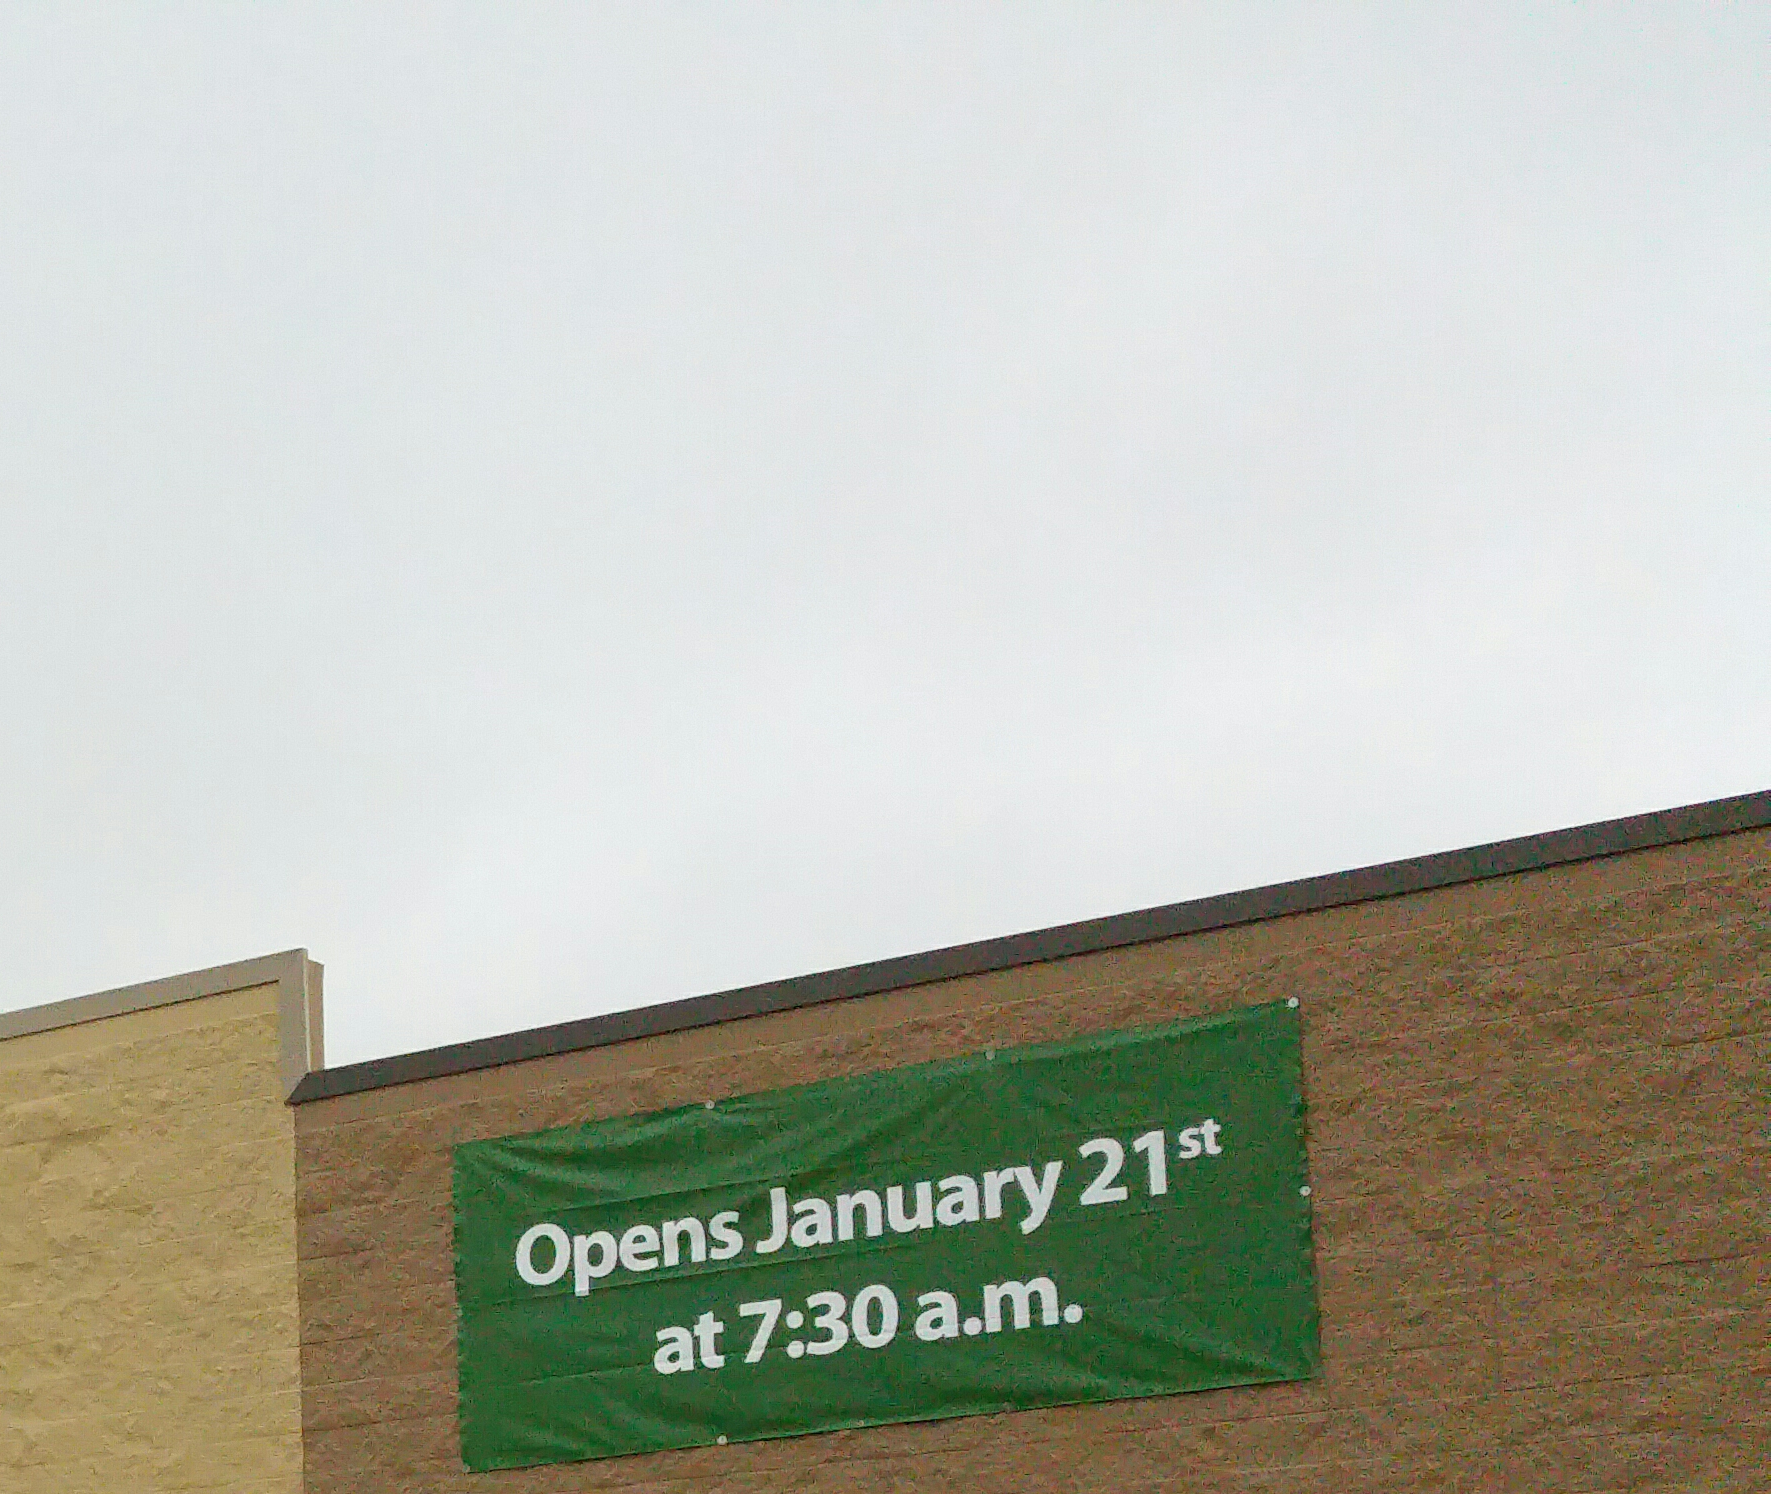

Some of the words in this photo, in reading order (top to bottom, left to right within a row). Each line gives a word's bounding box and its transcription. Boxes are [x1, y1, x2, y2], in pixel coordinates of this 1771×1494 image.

[514, 1210, 745, 1297] Opens
[754, 1158, 1062, 1255] January
[1078, 1116, 1224, 1205] 21st
[652, 1308, 725, 1376] at
[738, 1283, 899, 1365] 7:30
[914, 1275, 1084, 1343] a.m.
